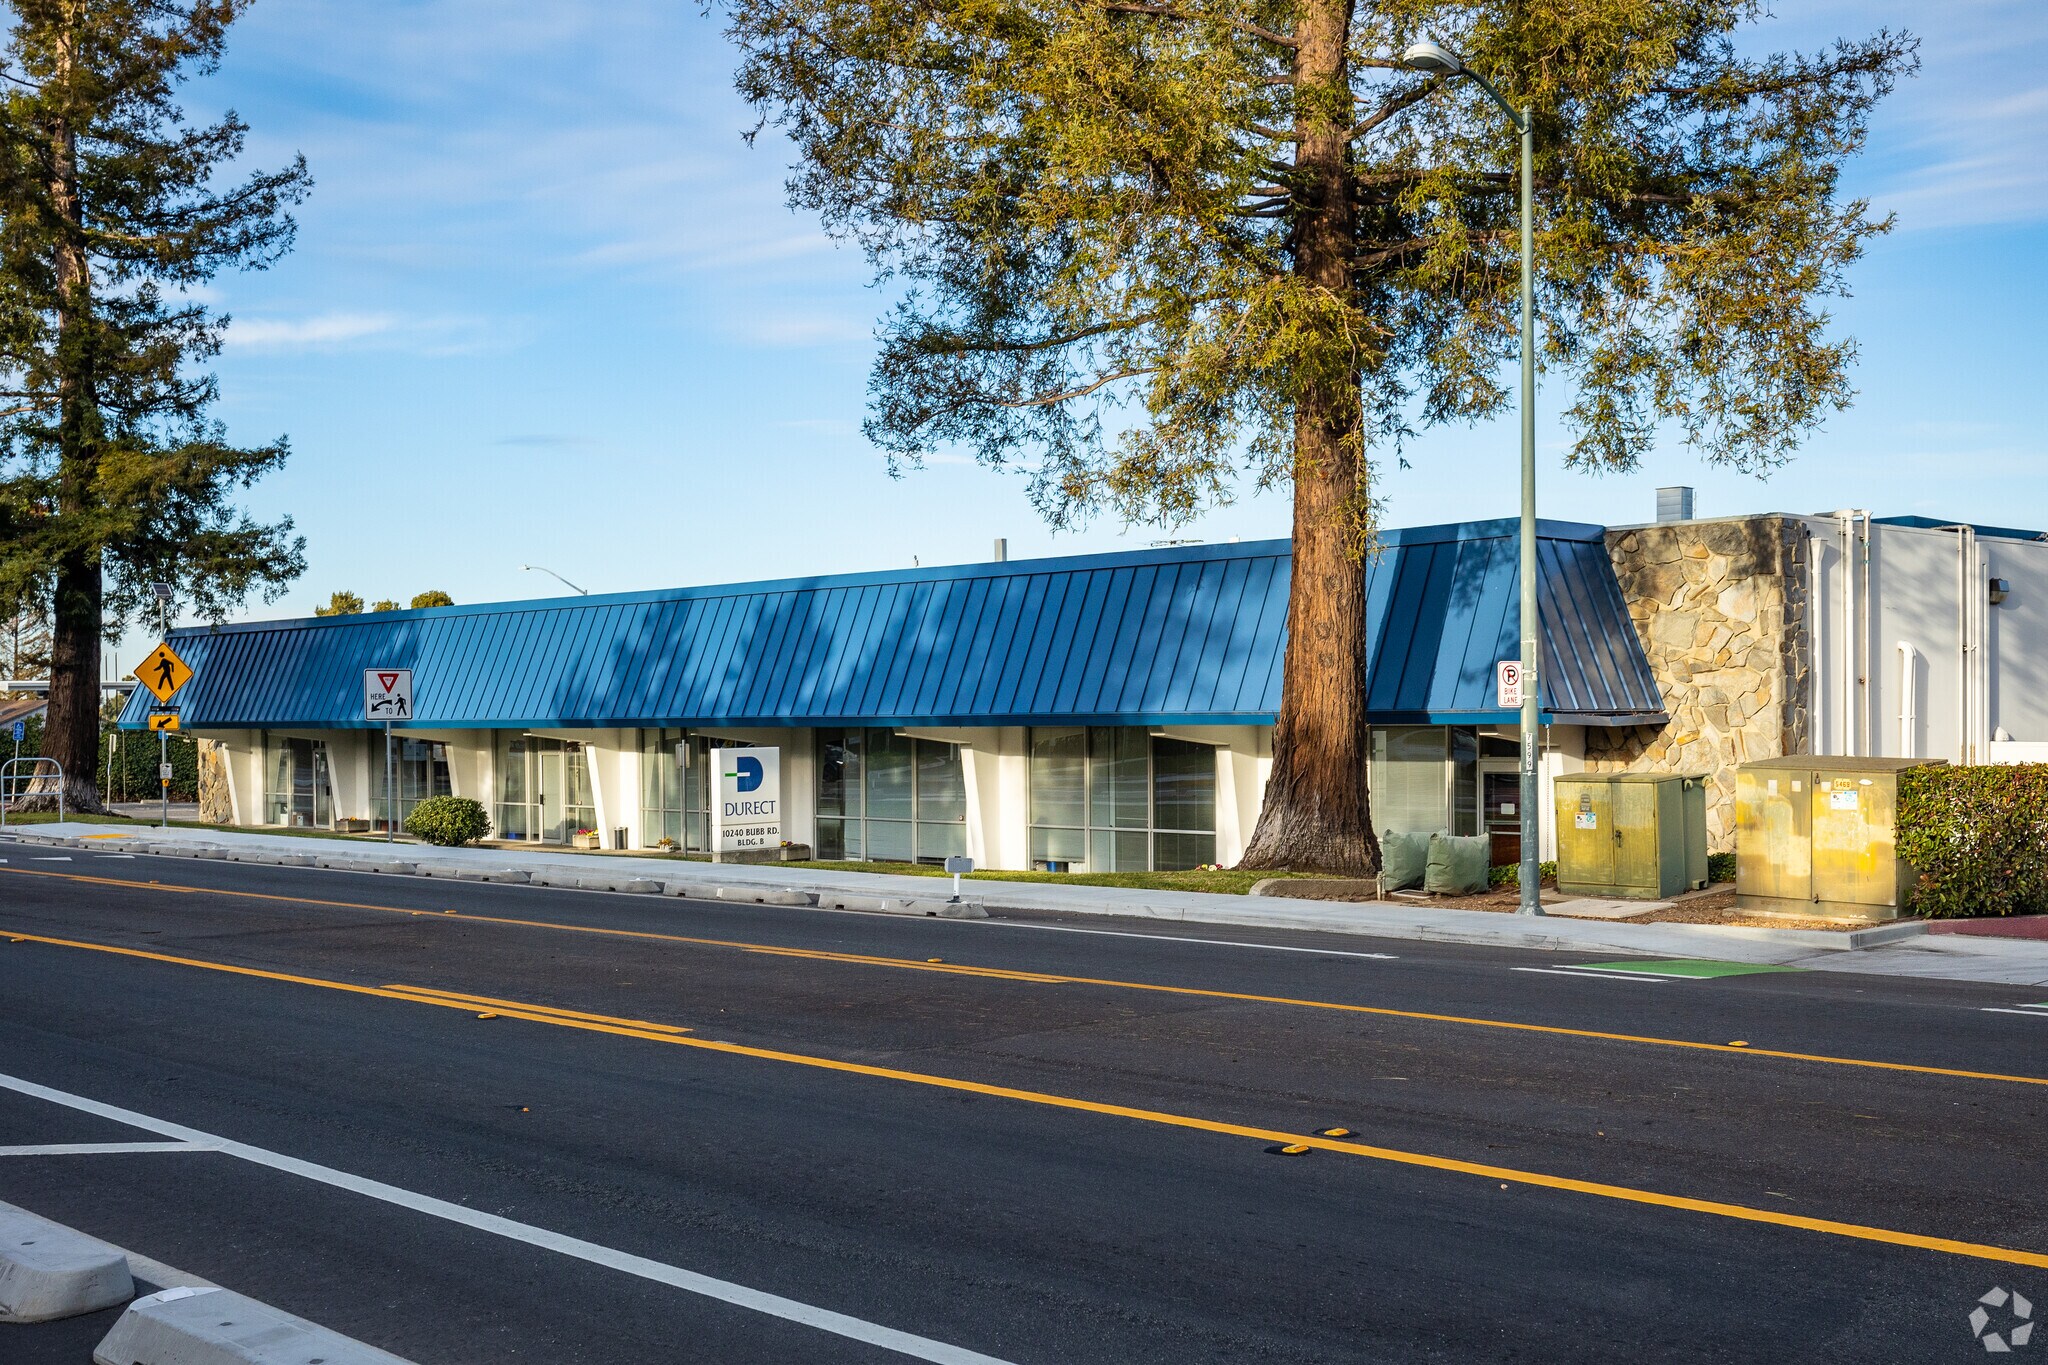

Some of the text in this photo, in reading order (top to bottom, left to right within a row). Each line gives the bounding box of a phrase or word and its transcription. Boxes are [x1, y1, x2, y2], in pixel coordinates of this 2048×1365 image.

[1504, 687, 1518, 695] BIKE
[1504, 696, 1518, 704] LANE
[385, 707, 393, 715] TO
[725, 800, 776, 816] DURECT
[722, 826, 779, 838] 10240 BUBB RD.
[737, 838, 758, 847] BLDG.
